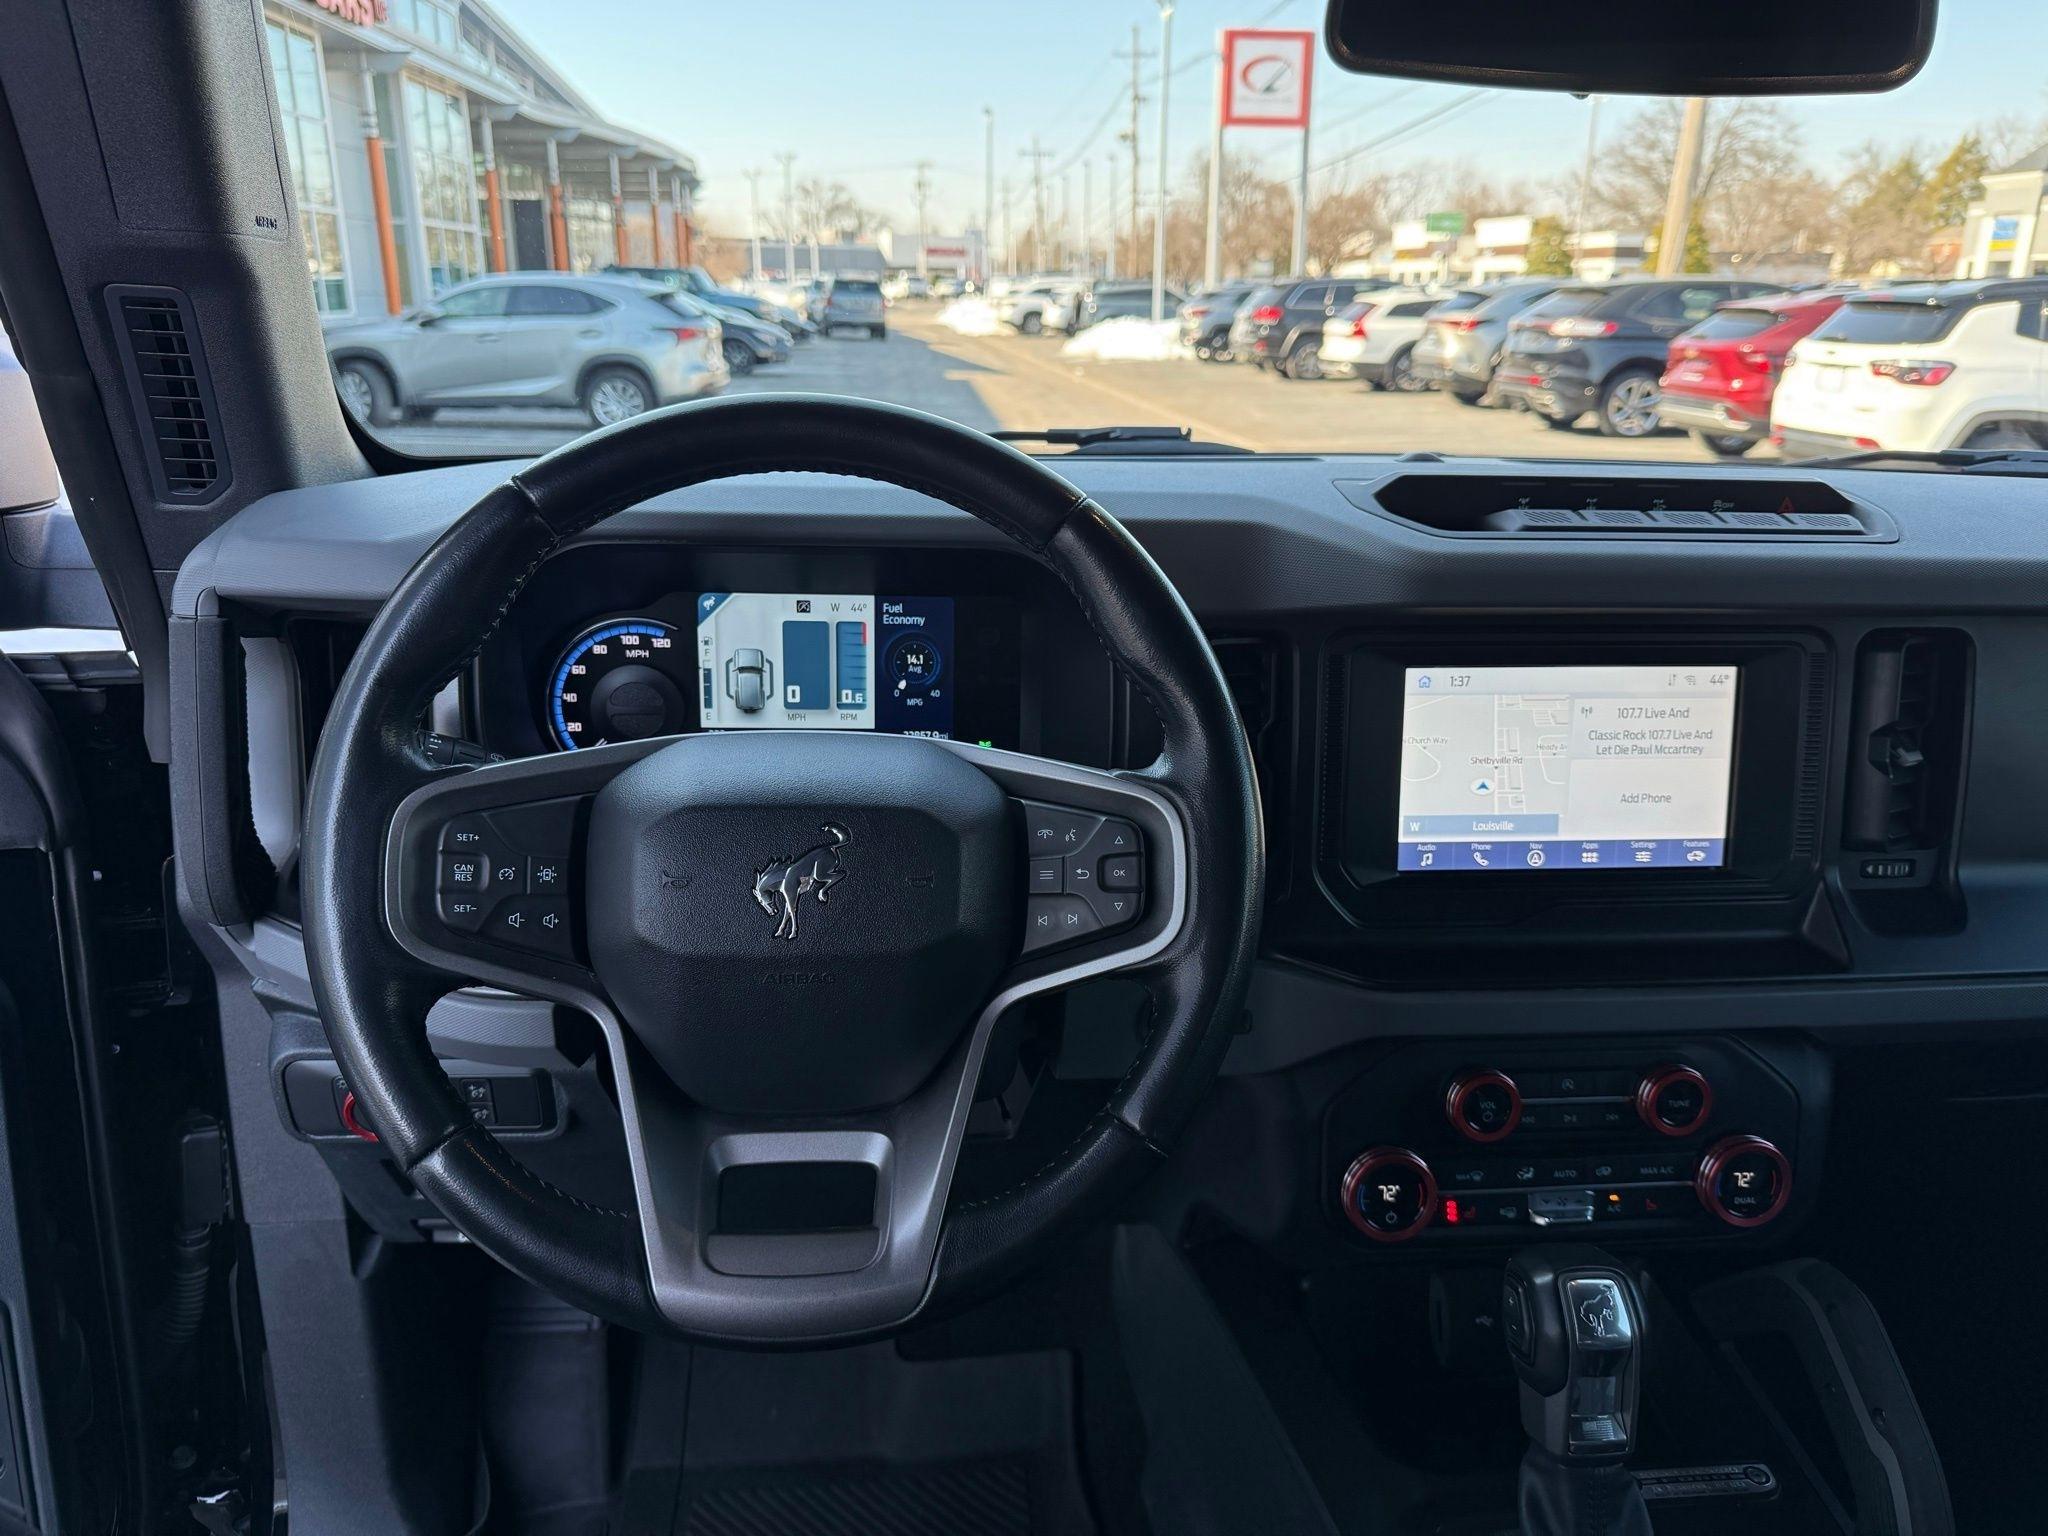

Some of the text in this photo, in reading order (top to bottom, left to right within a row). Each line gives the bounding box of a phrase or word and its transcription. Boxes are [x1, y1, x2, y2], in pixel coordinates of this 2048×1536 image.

[830, 602, 841, 612] W
[882, 602, 903, 614] Fuel
[882, 614, 926, 627] Economy
[620, 635, 640, 645] 100
[651, 638, 671, 648] 120
[592, 645, 608, 655] 80
[625, 650, 650, 658] MPH
[906, 654, 924, 665] 14.1
[571, 665, 586, 675] 60
[908, 665, 922, 674] Avg
[1449, 675, 1471, 688] 1:37
[563, 693, 578, 703] 40
[786, 685, 801, 703] 0
[841, 689, 864, 704] 0.6
[930, 689, 941, 697] 40
[906, 698, 924, 706] MPG
[787, 713, 807, 721] MPH
[840, 713, 858, 721] RPM
[1617, 707, 1690, 719] 107.7 Live And
[567, 722, 582, 732] 20
[1588, 729, 1713, 741] Classic Rock 107.7 Live And
[1596, 744, 1704, 756] Let Die Paul Mccartney
[1470, 756, 1511, 767] Shelbyville
[1620, 793, 1672, 804] Add Phone
[1409, 821, 1515, 832] W Louisville
[456, 833, 480, 842] SET+
[1417, 843, 1436, 851] Audio
[1471, 843, 1492, 851] Phone
[1529, 842, 1543, 850] Nav
[1630, 840, 1657, 849] Settings
[1683, 840, 1710, 848] Features
[453, 863, 475, 871] CAN
[454, 873, 473, 882] RES
[1113, 869, 1126, 877] OK
[761, 972, 837, 984] AIRBAG
